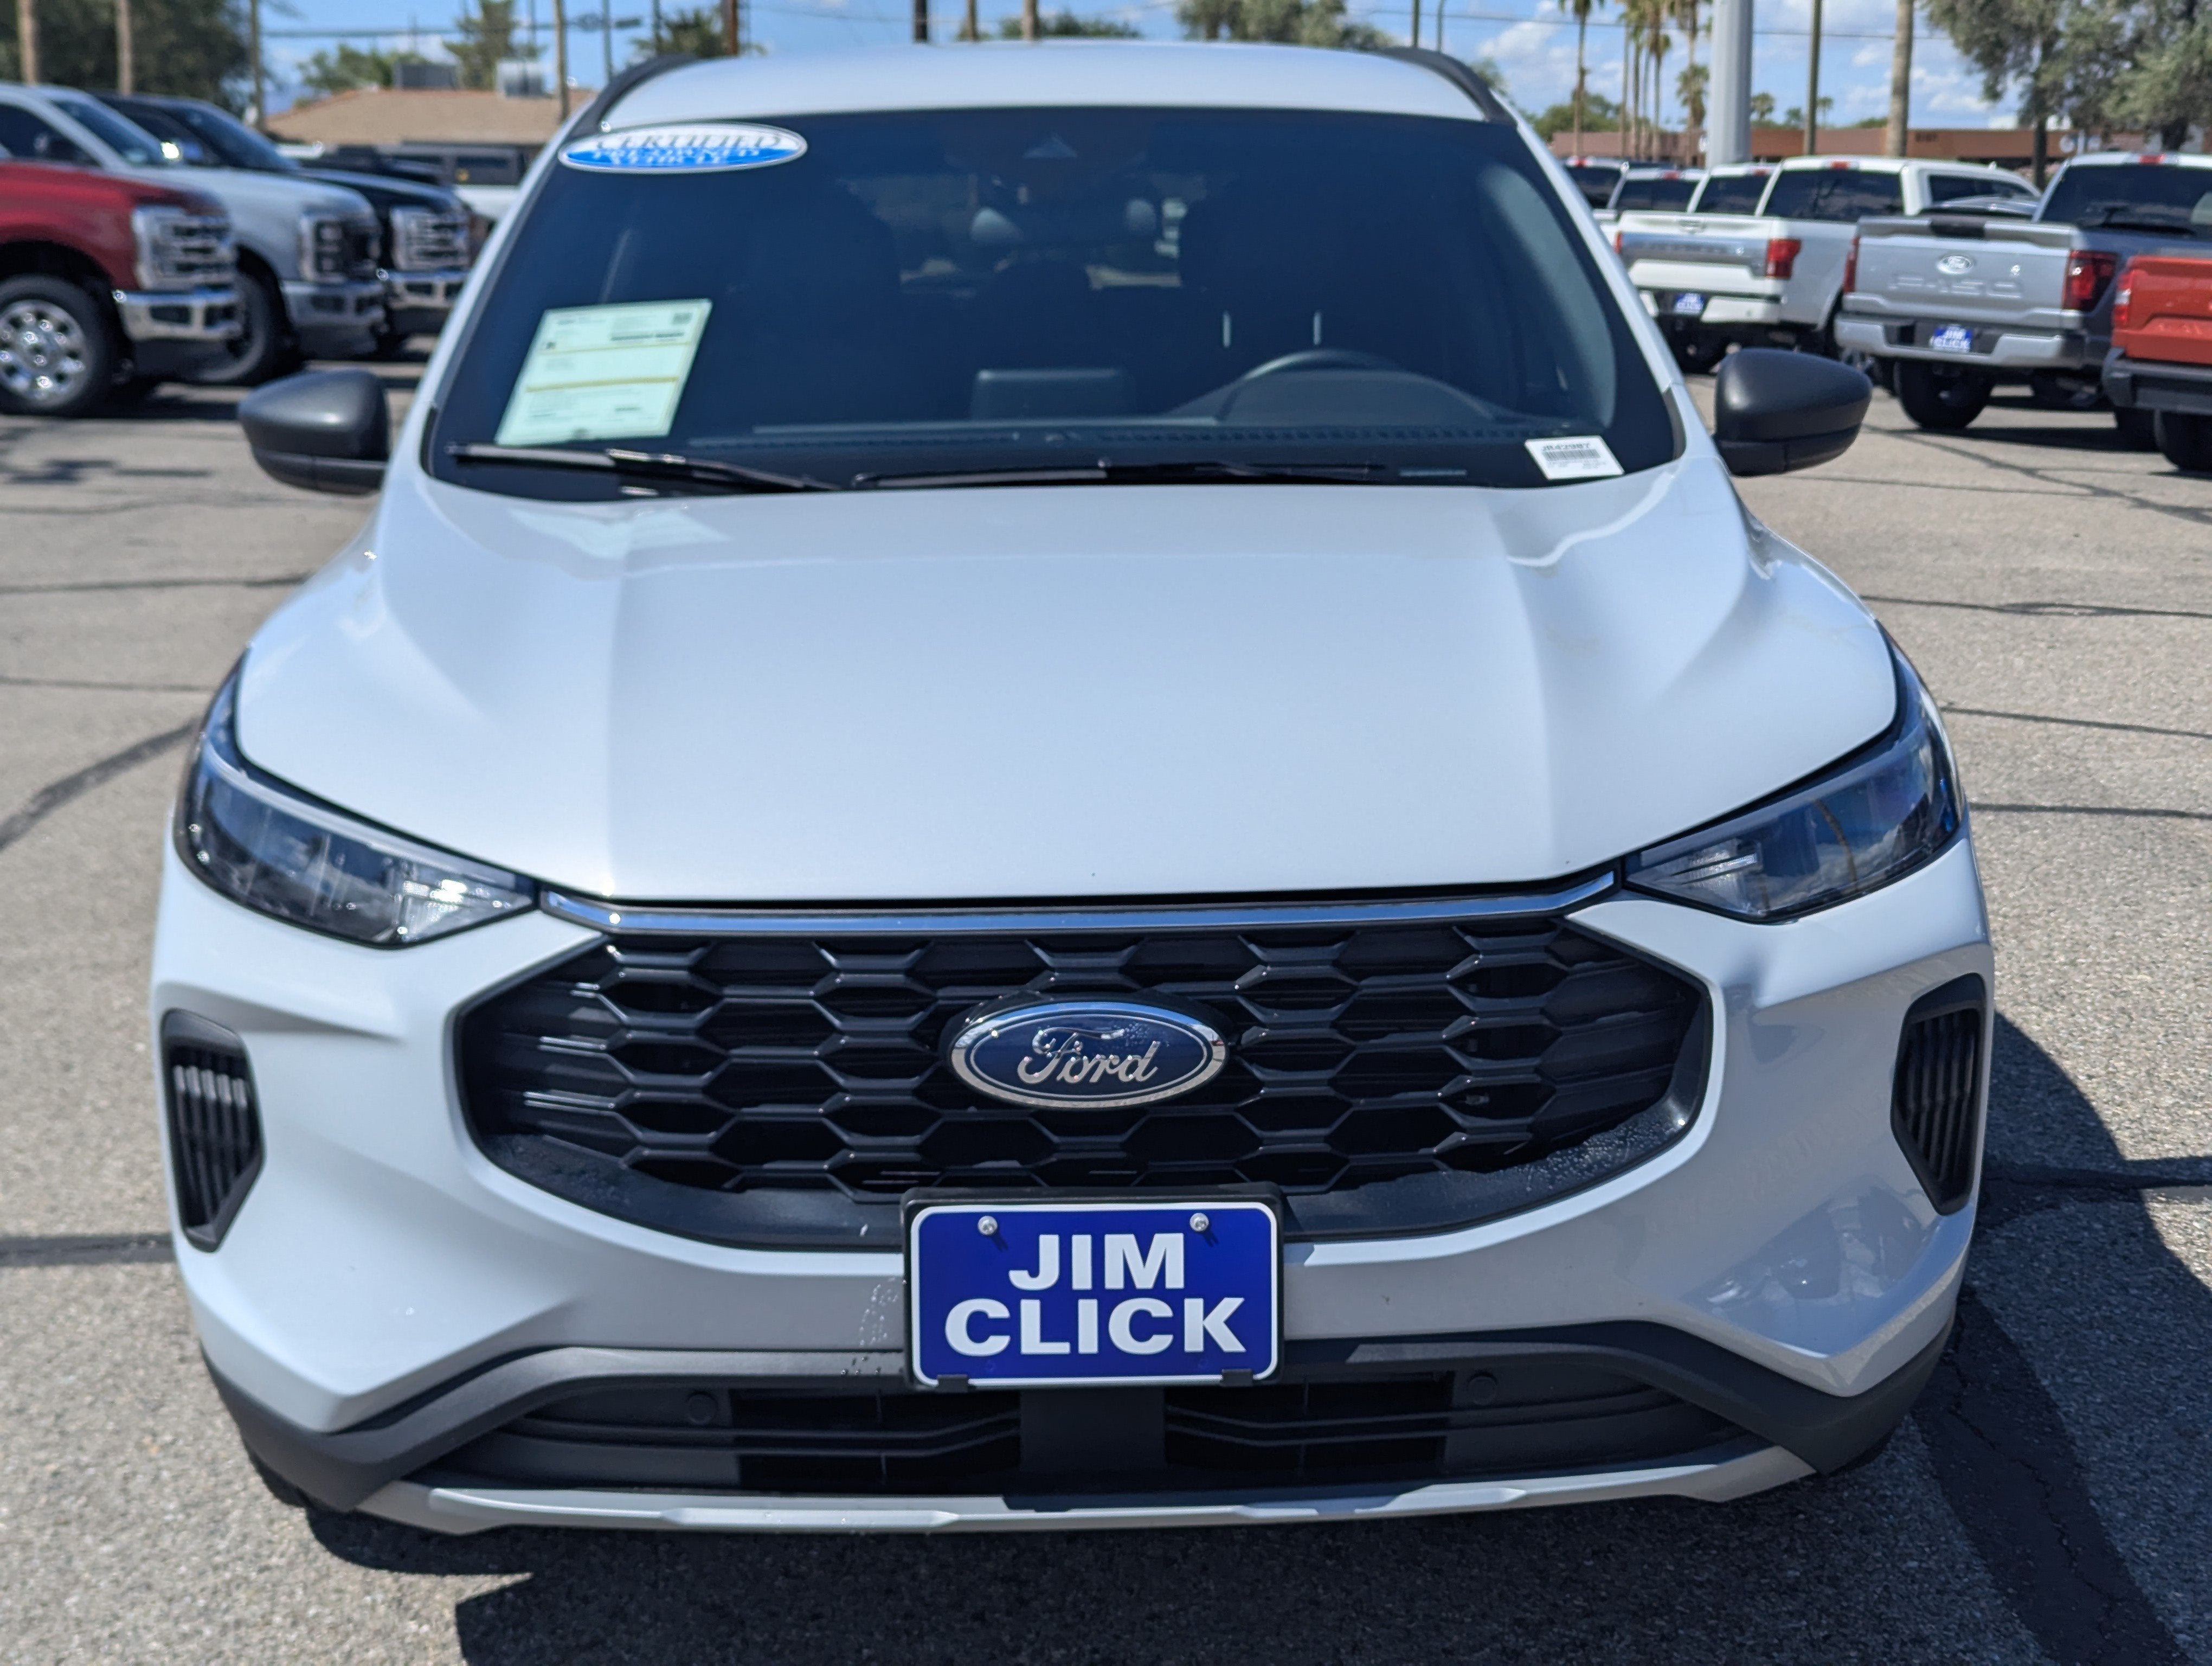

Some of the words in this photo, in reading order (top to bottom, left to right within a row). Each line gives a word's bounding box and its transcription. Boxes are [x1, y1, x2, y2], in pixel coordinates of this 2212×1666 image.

[1017, 1027, 1159, 1084] Ford
[1008, 1233, 1185, 1291] JIM
[944, 1297, 1246, 1357] CLICK
